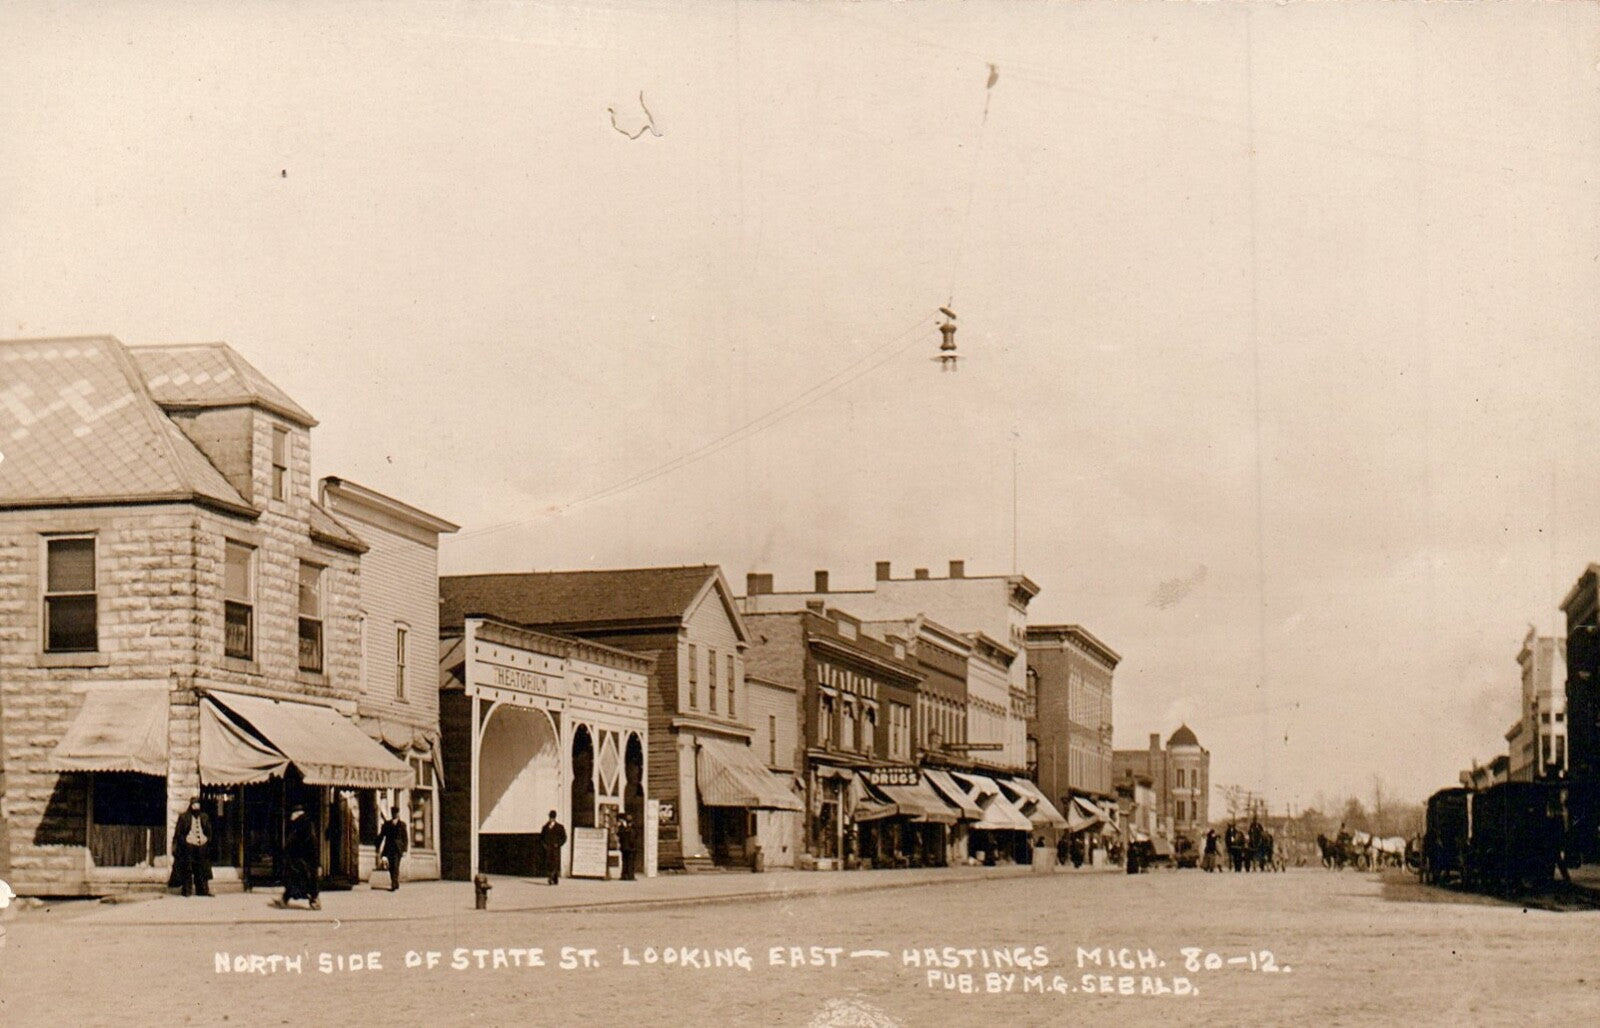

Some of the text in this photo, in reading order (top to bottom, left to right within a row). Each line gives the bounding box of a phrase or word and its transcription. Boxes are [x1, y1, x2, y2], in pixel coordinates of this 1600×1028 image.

[494, 666, 547, 693] THEATORIUM
[583, 677, 627, 701] TEMPLE
[871, 773, 917, 785] DRUGS
